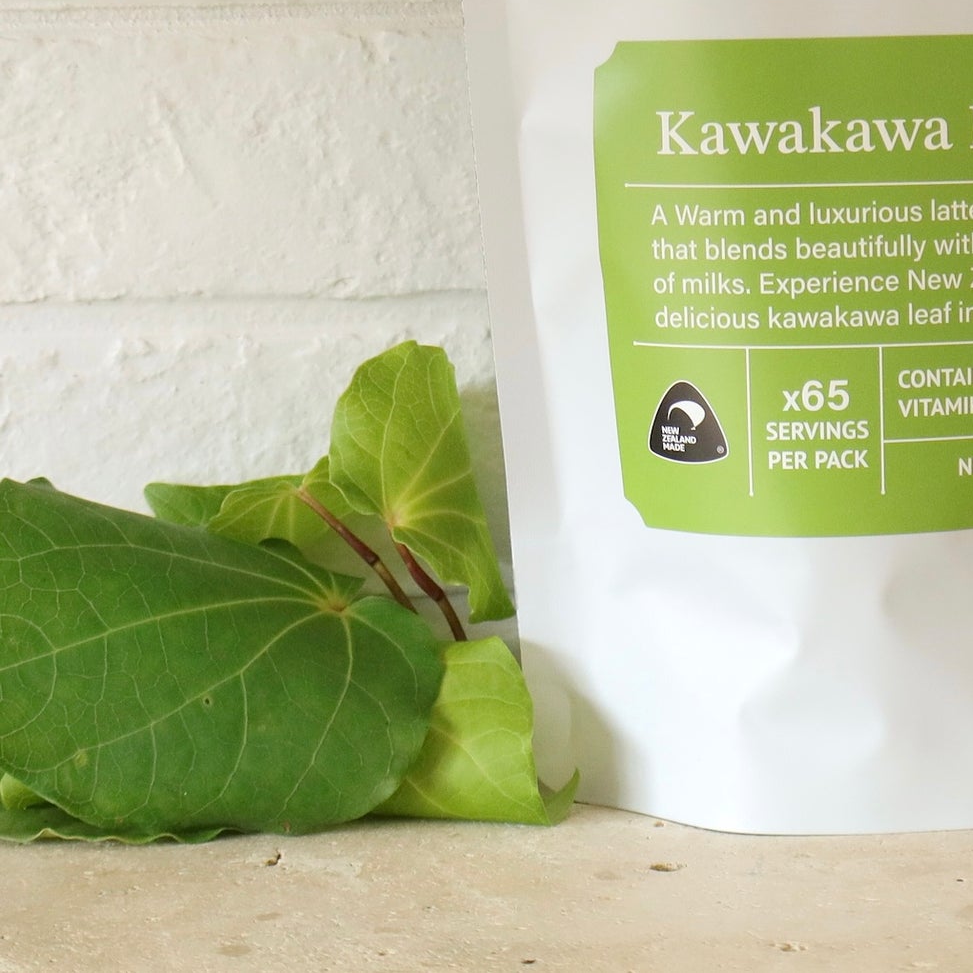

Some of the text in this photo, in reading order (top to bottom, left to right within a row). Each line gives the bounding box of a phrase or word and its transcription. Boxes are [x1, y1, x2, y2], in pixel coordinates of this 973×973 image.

[655, 105, 954, 156] Kawakawa
[651, 204, 668, 226] A
[674, 204, 745, 226] Warm
[753, 202, 801, 226] and
[809, 200, 923, 225] luxurious
[651, 237, 698, 260] that
[704, 237, 788, 261] blends
[795, 233, 927, 262] beautifully
[653, 271, 676, 294] of
[682, 271, 751, 295] milks.
[759, 270, 899, 300] Experience
[907, 269, 963, 291] New
[655, 305, 760, 329] delicious
[768, 304, 899, 329] kawakawa
[908, 300, 952, 326] leaf
[782, 379, 850, 412] x65
[661, 426, 679, 435] NEW
[662, 435, 696, 444] ZEALAND
[765, 419, 870, 441] SERVINGS
[663, 443, 685, 452] MADE
[767, 449, 869, 470] PER PACK
